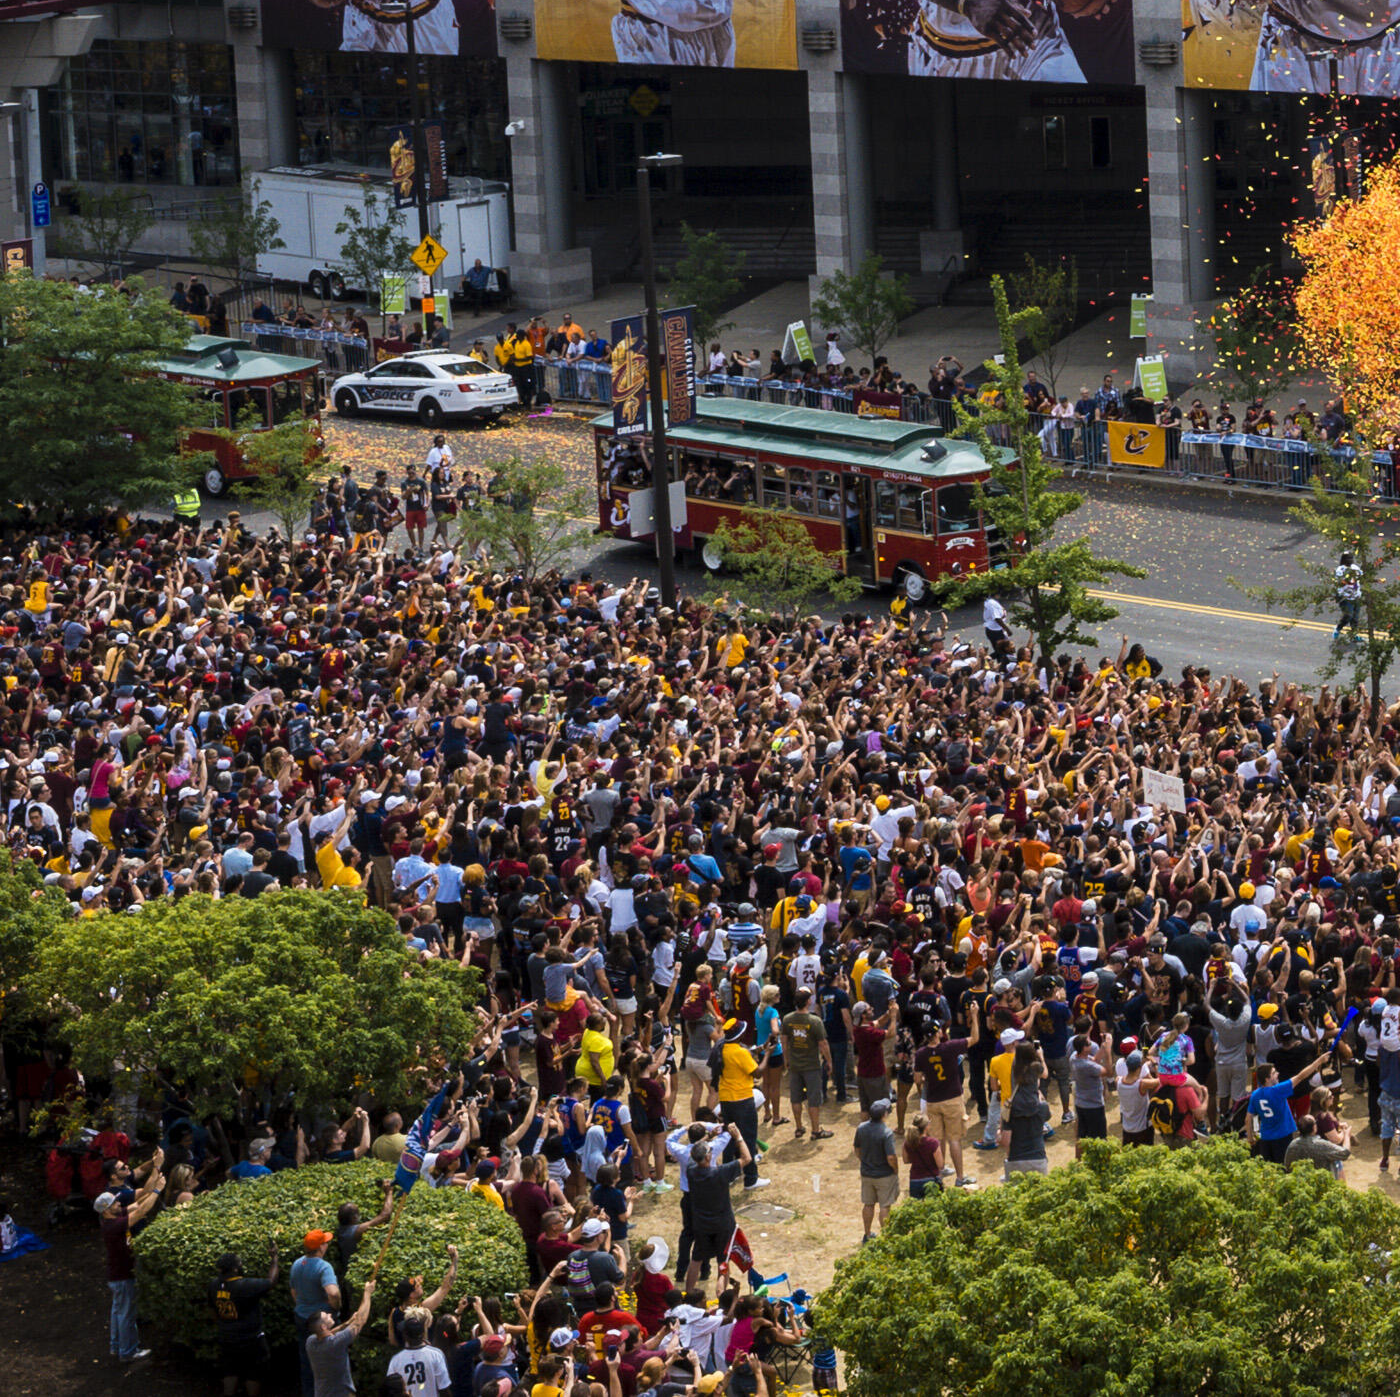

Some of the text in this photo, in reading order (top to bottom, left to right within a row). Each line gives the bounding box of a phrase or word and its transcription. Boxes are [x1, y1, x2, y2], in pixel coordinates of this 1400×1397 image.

[37, 184, 44, 194] P
[667, 316, 688, 422] CAVALIERS
[684, 338, 695, 396] CLEVELAND
[374, 389, 415, 402] POLICE
[485, 387, 507, 395] POLICE
[803, 972, 815, 984] 23
[1384, 1022, 1391, 1036] 2
[934, 1063, 946, 1081] 2
[1260, 1099, 1274, 1118] 5
[404, 1362, 426, 1384] 23
